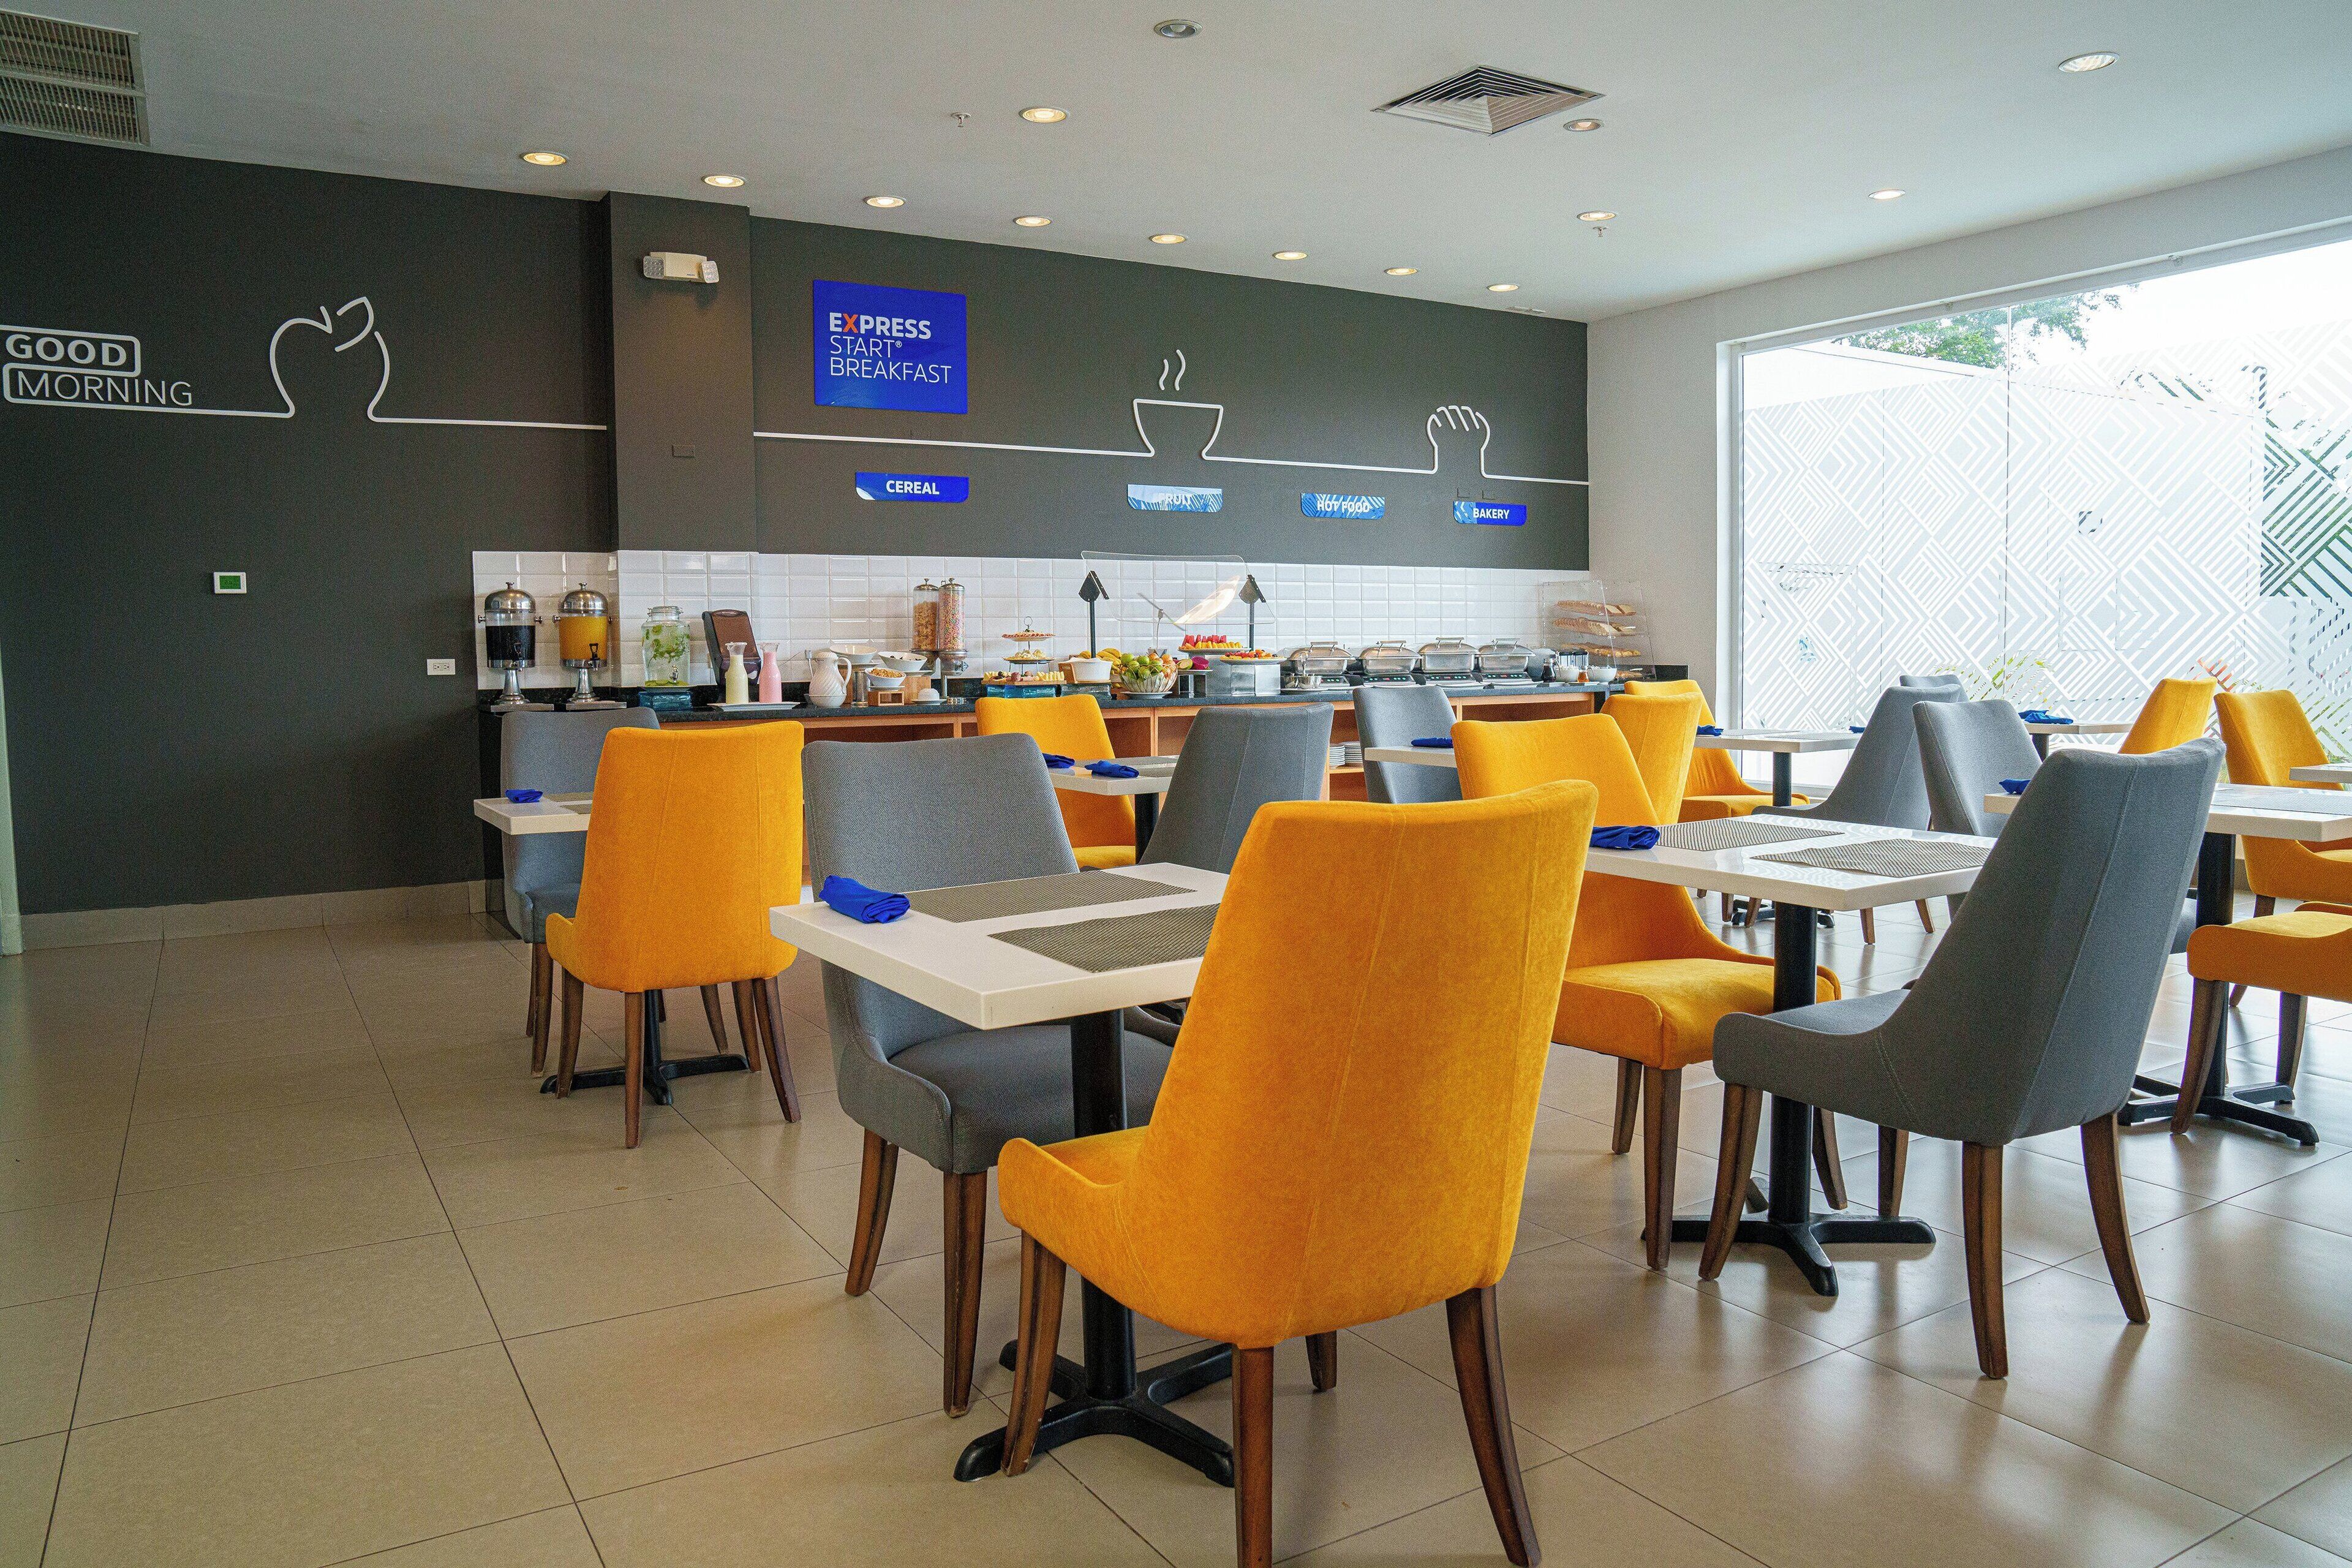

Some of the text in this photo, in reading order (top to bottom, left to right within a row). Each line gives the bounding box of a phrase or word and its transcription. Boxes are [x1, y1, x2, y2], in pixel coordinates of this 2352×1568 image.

[829, 312, 932, 340] EXPRESS
[6, 334, 127, 366] GOOD
[831, 356, 952, 384] BREAKFAST
[17, 370, 192, 406] MORNING
[886, 480, 940, 495] CEREAL
[1317, 500, 1370, 513] HOT FOOD
[1472, 508, 1510, 519] BAKERY
